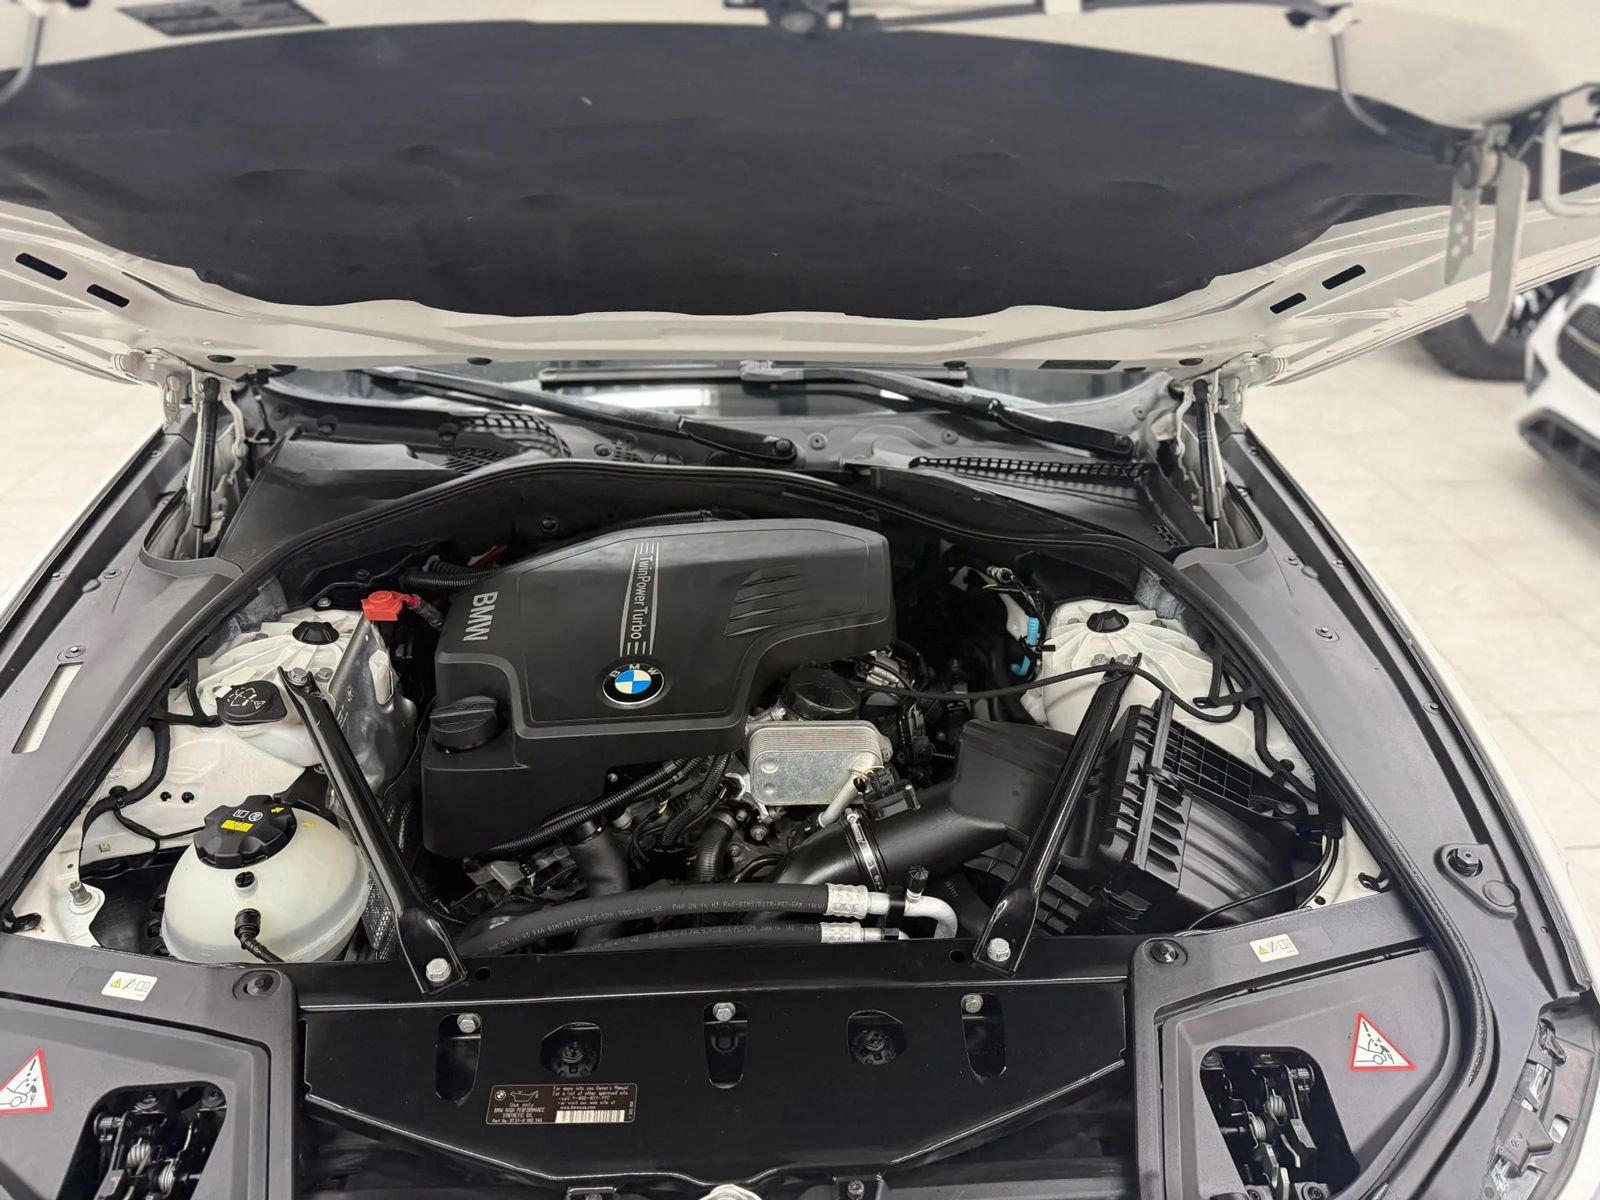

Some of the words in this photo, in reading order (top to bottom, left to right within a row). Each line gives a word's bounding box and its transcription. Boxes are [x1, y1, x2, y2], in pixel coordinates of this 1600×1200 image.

[634, 555, 653, 606] TwinPower
[463, 592, 498, 641] BMW
[630, 606, 649, 640] Turbo
[609, 663, 659, 678] BMW
